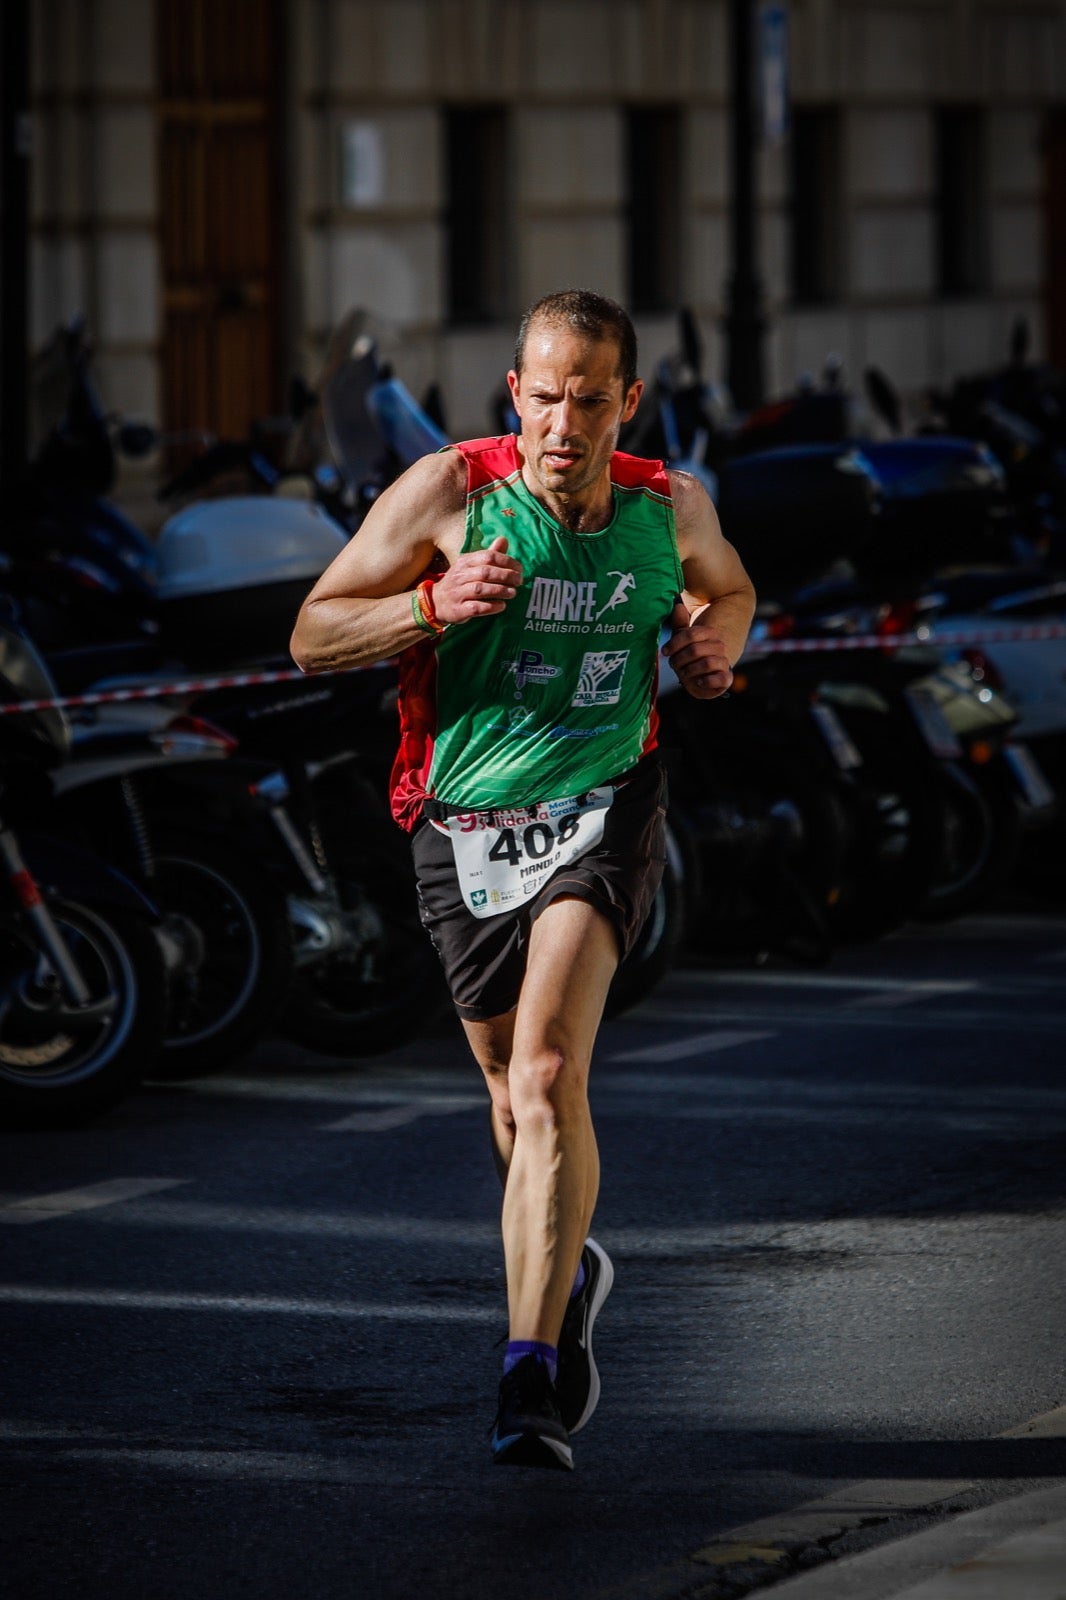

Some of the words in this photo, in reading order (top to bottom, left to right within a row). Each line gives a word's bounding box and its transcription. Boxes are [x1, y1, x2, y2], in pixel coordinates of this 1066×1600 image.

[525, 576, 598, 622] ATARFE
[524, 619, 590, 634] Atletismo
[593, 621, 635, 634] Atarfe
[489, 812, 580, 866] 408
[520, 851, 561, 879] MANOLO
